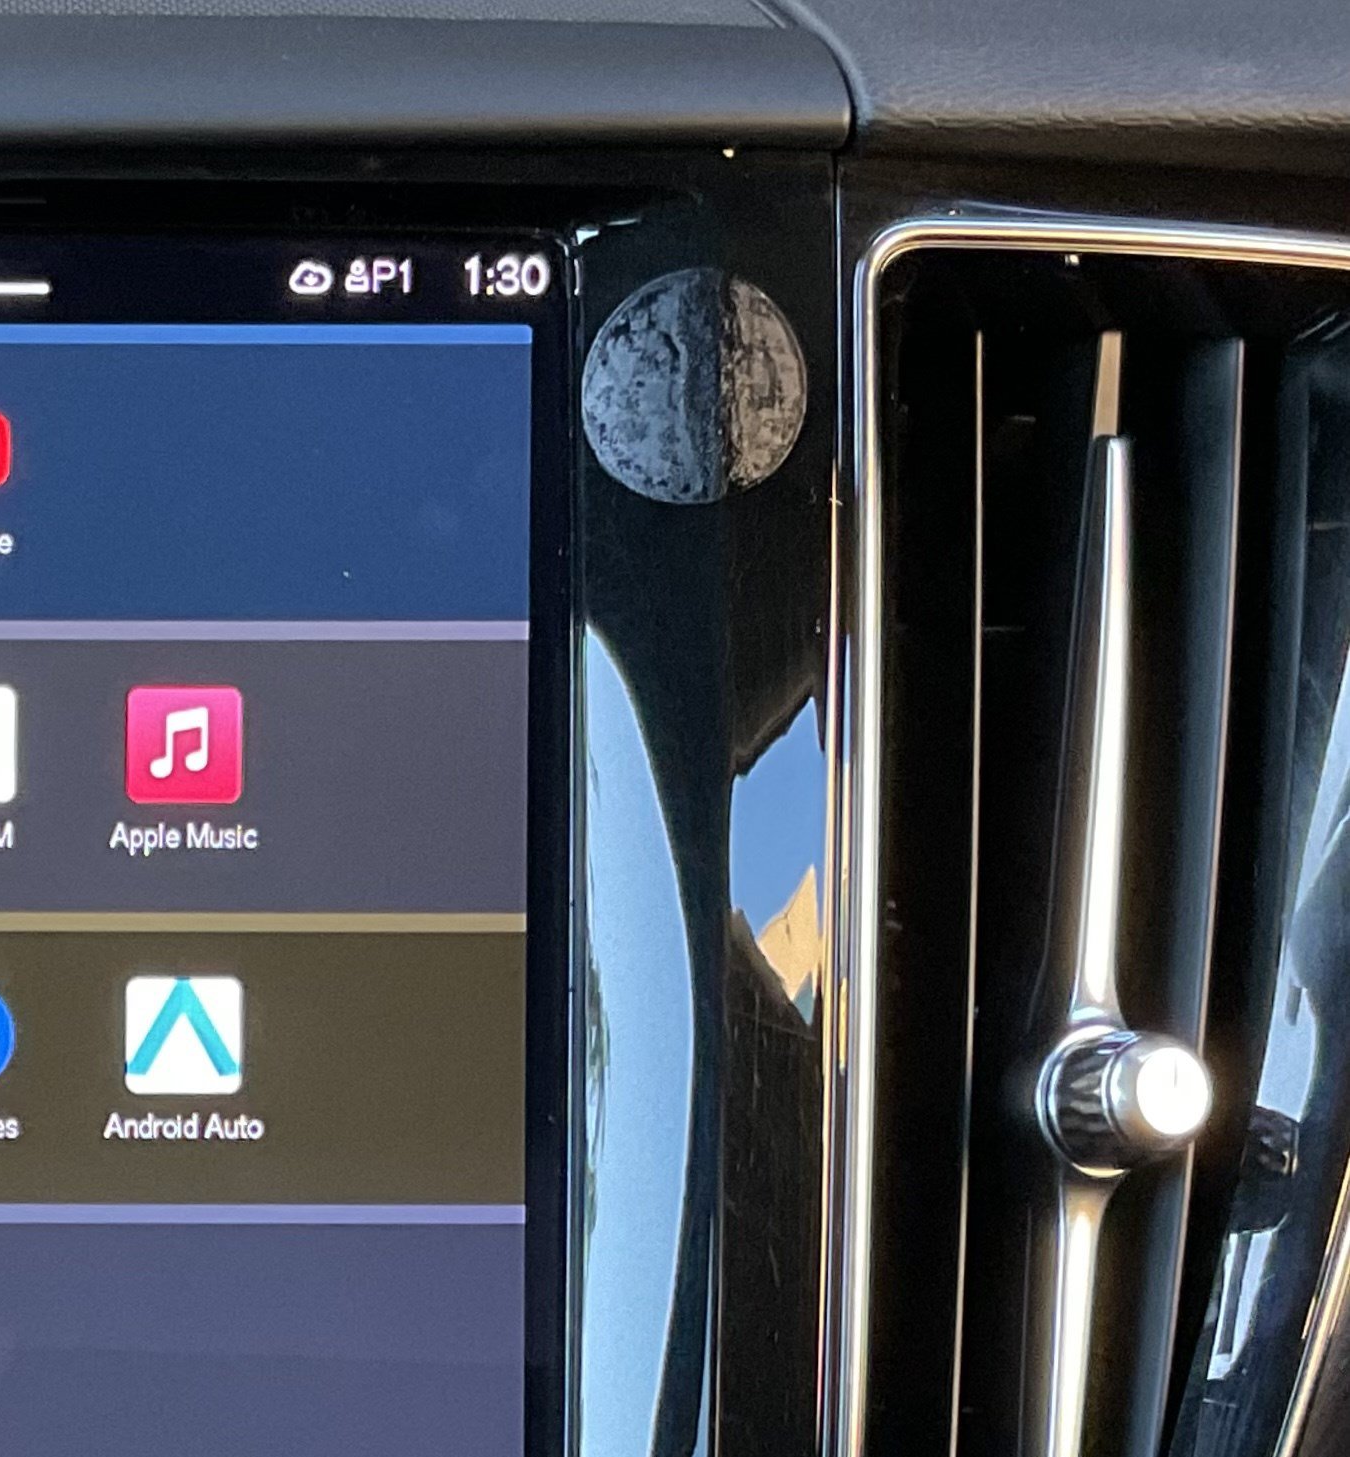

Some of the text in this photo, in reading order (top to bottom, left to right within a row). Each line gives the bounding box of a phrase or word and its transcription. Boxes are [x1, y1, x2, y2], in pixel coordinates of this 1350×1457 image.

[372, 258, 411, 294] P1
[464, 254, 550, 296] 1:30
[109, 821, 258, 857] Apple Music
[103, 1112, 265, 1140] Android Auto
